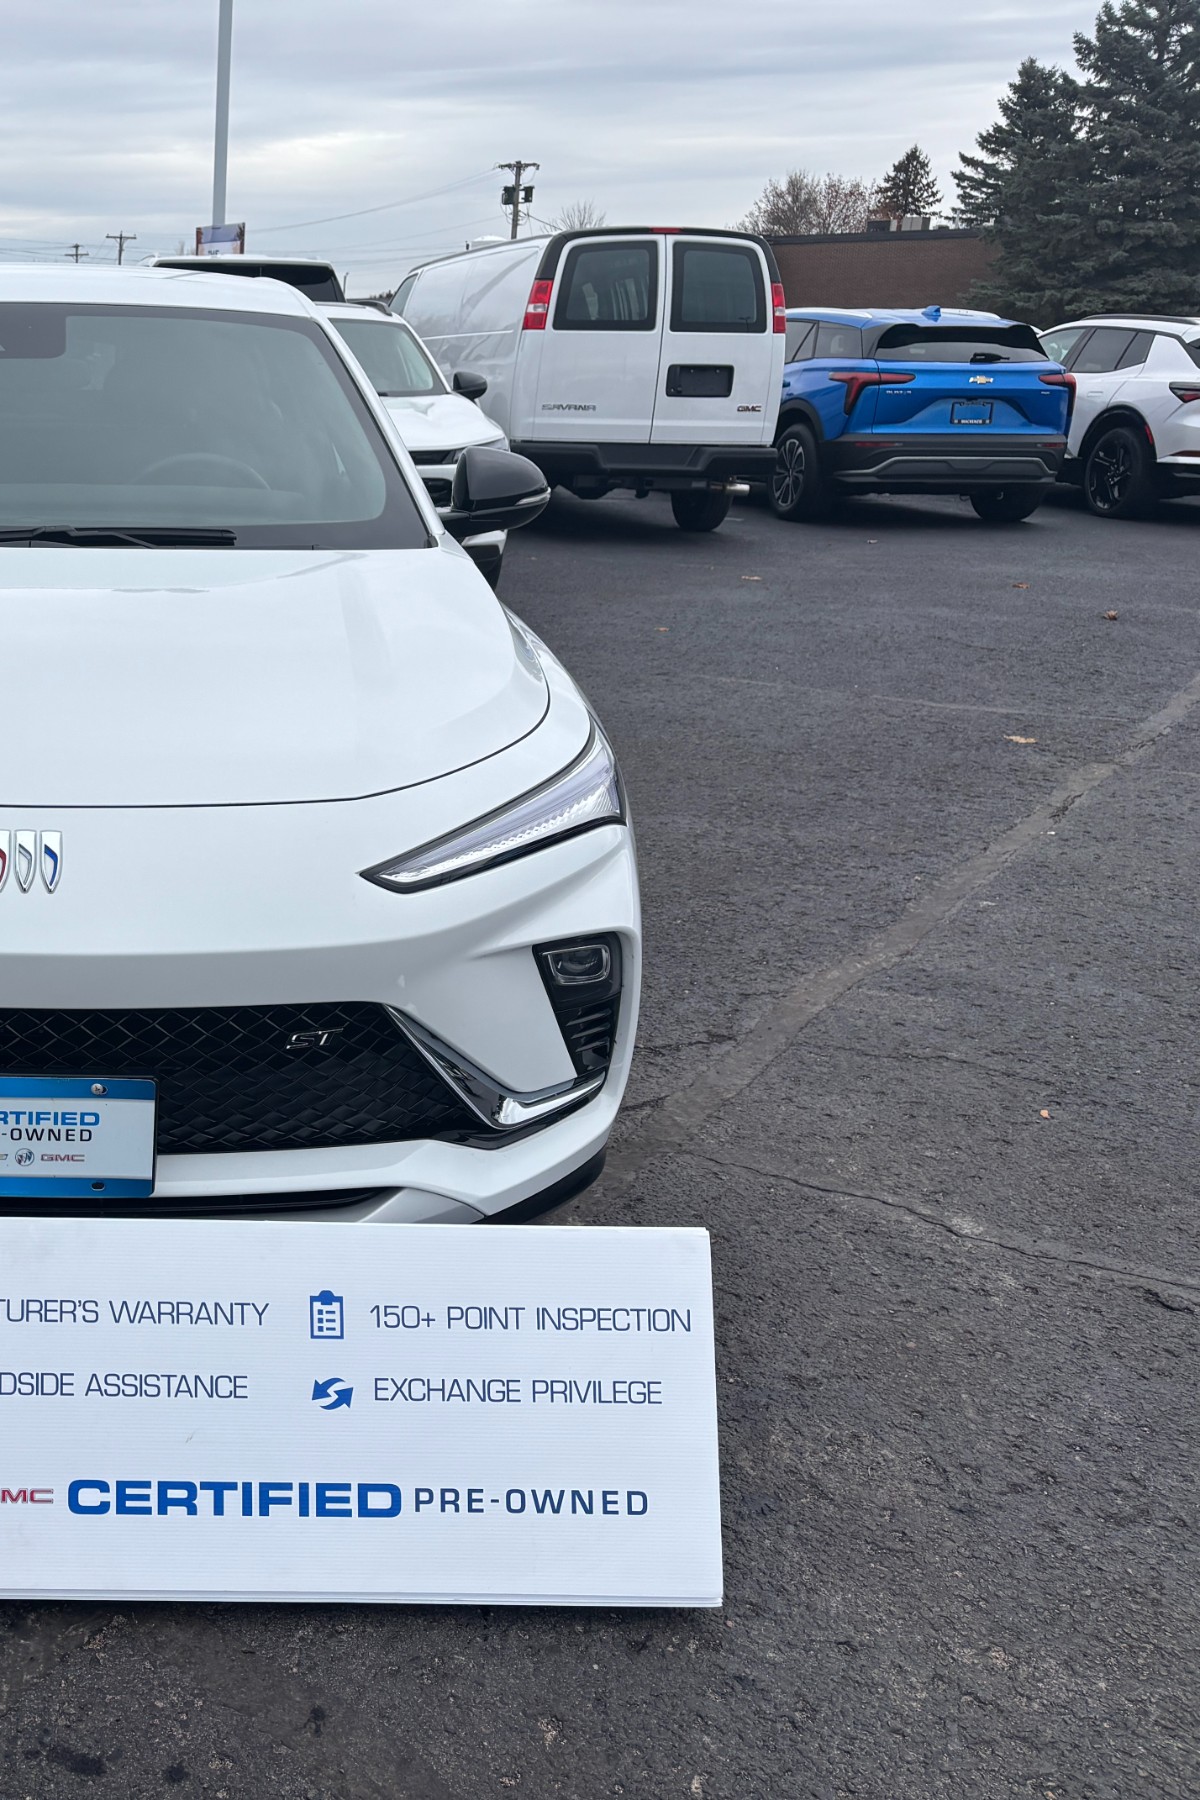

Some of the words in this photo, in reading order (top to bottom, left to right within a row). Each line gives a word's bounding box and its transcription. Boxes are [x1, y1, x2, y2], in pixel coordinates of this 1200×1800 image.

[541, 403, 597, 411] SAVANA
[286, 1027, 343, 1049] ST
[40, 1153, 85, 1162] GMC
[109, 1301, 269, 1325] WARRANTY
[370, 1305, 435, 1328] 150+
[448, 1307, 525, 1329] POINT
[537, 1308, 690, 1332] INSPECTION
[85, 1374, 248, 1398] ASSISTANCE
[375, 1378, 521, 1402] EXCHANGE
[533, 1380, 662, 1404] PRIVILEGE
[68, 1480, 401, 1517] CERTIFIED
[415, 1488, 647, 1515] PRE-OWNED
